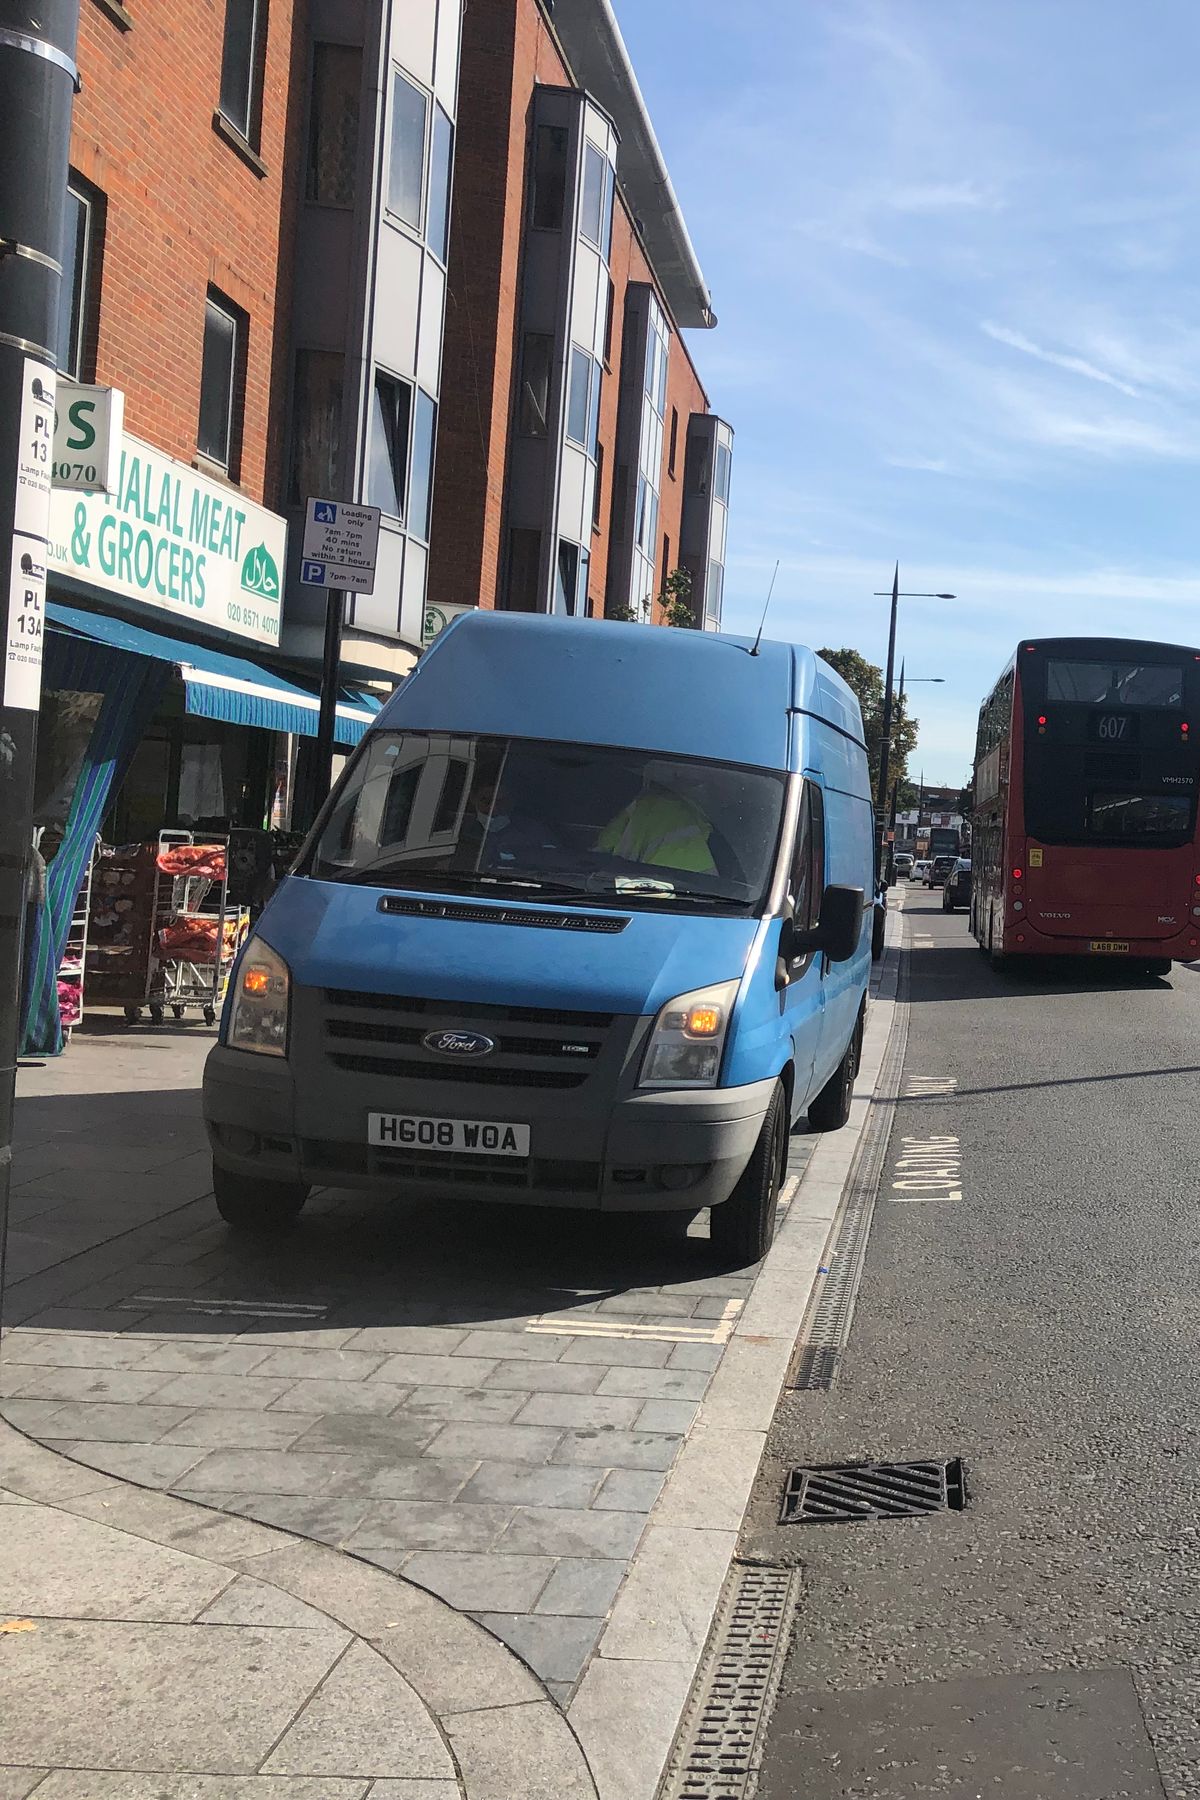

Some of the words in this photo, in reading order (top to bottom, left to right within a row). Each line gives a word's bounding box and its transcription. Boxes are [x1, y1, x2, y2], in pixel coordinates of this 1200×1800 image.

[34, 414, 49, 439] PL
[66, 400, 96, 450] S
[31, 440, 47, 462] 13
[20, 463, 40, 477] Lamp
[52, 461, 97, 482] 4070
[189, 488, 246, 562] MEAT
[341, 508, 372, 521] Loading
[347, 519, 364, 528] only
[321, 544, 334, 552] No
[336, 547, 362, 557] return
[326, 536, 338, 544] 40
[340, 539, 360, 548] mins
[71, 502, 91, 568] &
[98, 514, 206, 609] GROCERS
[311, 552, 336, 560] within
[348, 556, 371, 567] hours
[308, 565, 322, 580] P
[24, 589, 41, 611] PL
[227, 604, 241, 622] 020
[243, 609, 260, 629] 8571
[261, 615, 279, 636] 4070
[9, 639, 30, 652] Lamp
[1099, 716, 1128, 738] 607
[1162, 776, 1194, 785] VMH2570
[438, 1033, 477, 1052] Ford
[380, 1117, 454, 1146] HG08
[463, 1123, 518, 1151] WOA
[888, 1136, 963, 1202] LOADING
